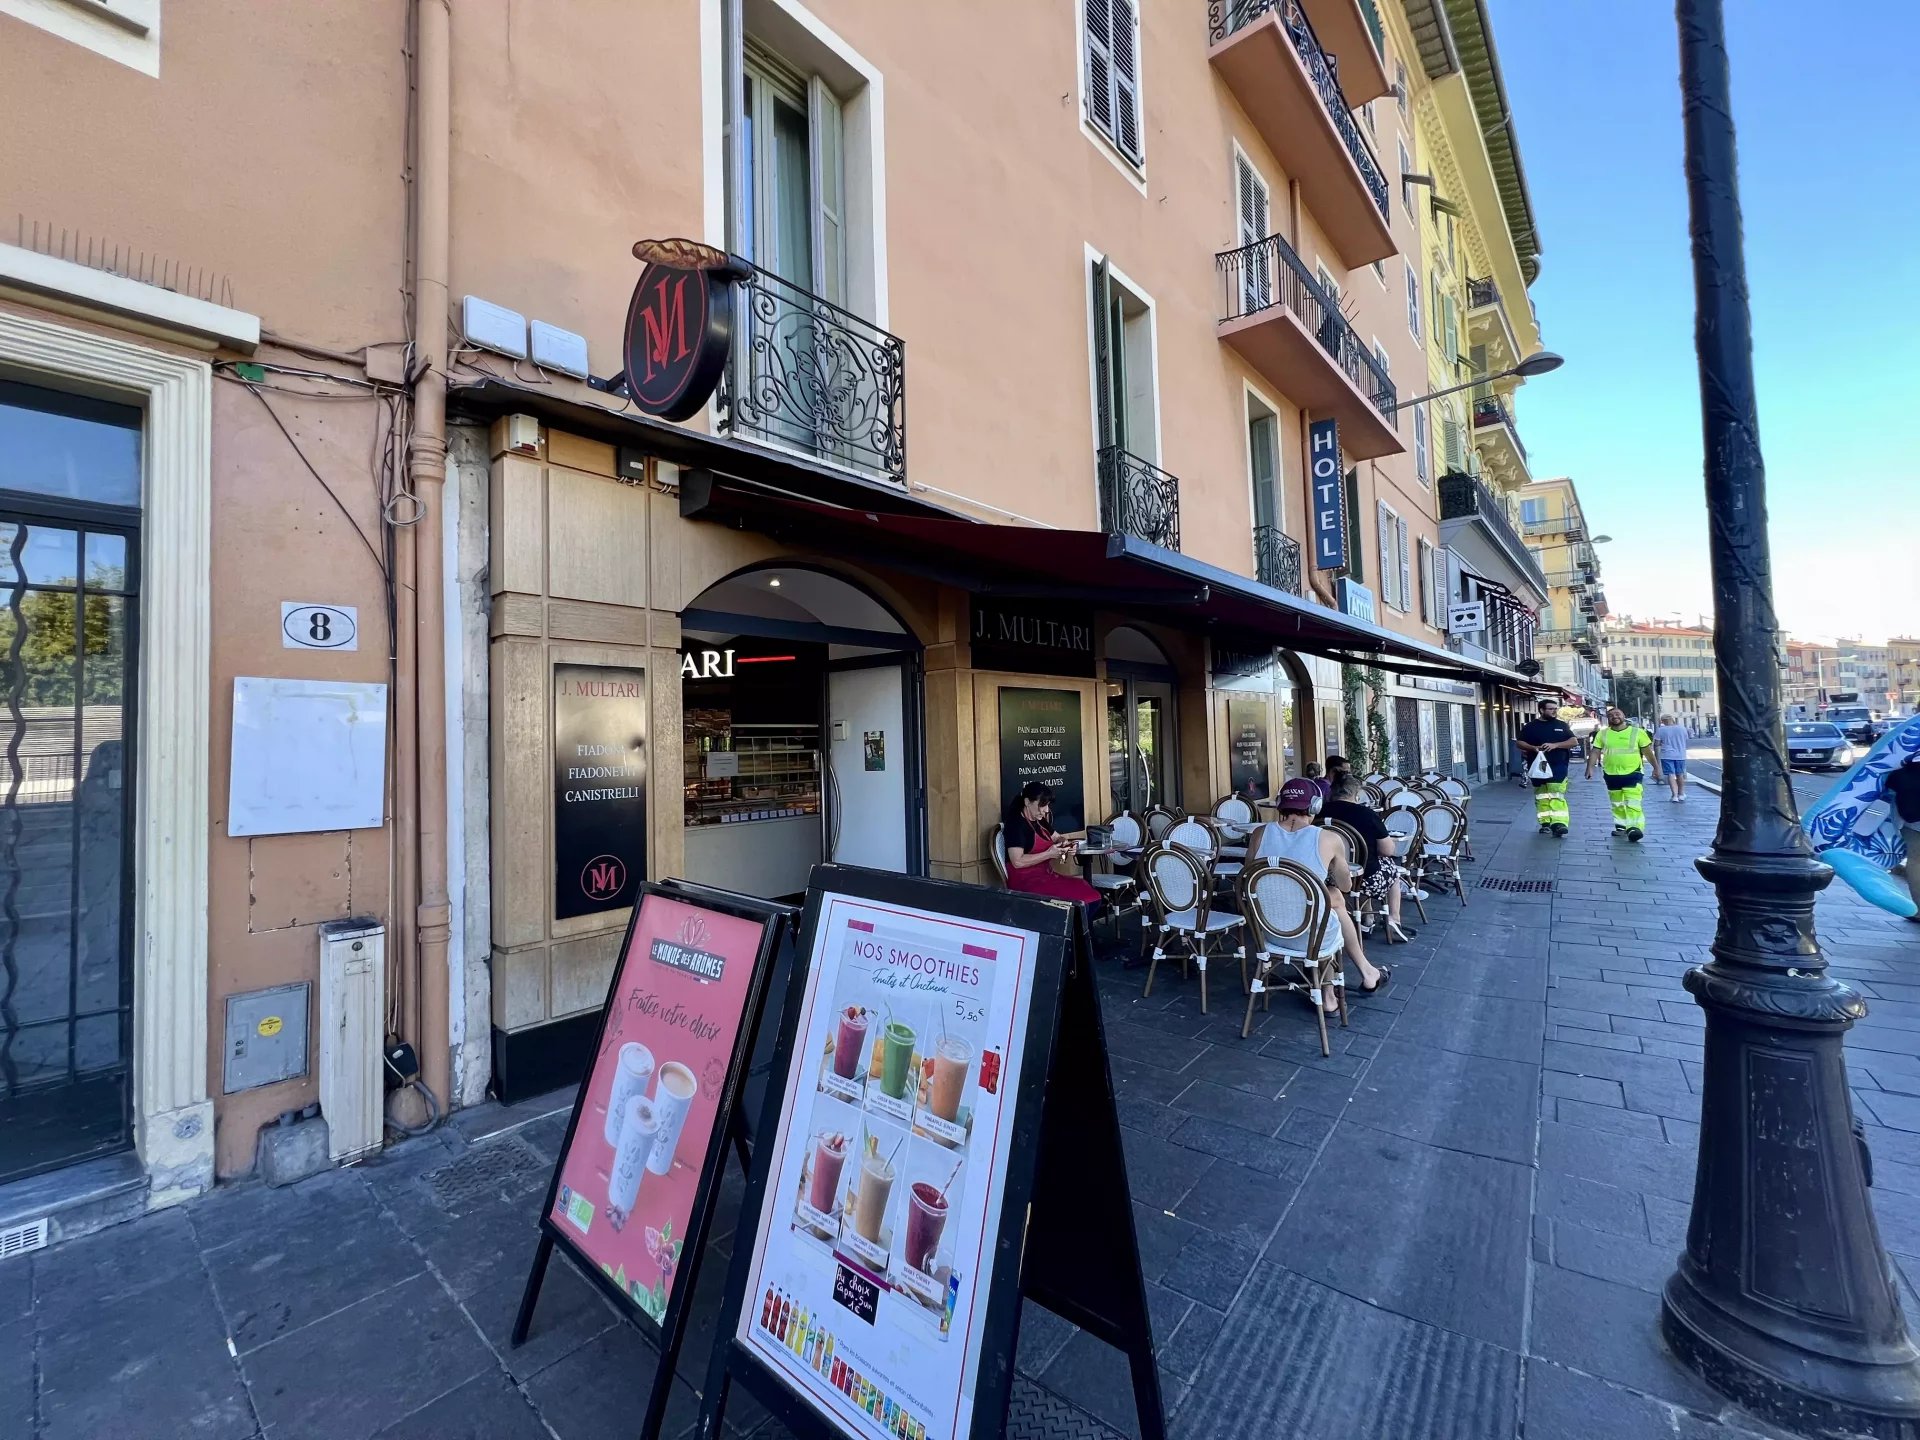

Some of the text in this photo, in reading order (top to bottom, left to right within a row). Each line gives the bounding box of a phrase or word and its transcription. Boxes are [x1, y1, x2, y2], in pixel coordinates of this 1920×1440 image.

[1313, 430, 1337, 557] HOTEL
[309, 612, 331, 641] 8
[976, 609, 1090, 651] J. MULTARI
[562, 680, 640, 698] J. MULTARI
[1017, 726, 1030, 734] PAIN
[1036, 739, 1042, 747] de
[1023, 752, 1061, 761] PAIN COMPLET
[1018, 764, 1067, 775] PAIN de CAMPAGNE
[1044, 778, 1064, 787] OLIVES
[565, 786, 640, 803] CANISTRELLI
[651, 944, 658, 956] LE
[656, 943, 682, 966] MONDE
[680, 953, 692, 966] DES
[689, 953, 724, 979] ARÔMES
[853, 940, 979, 986] NOS SMOOTHIES
[898, 974, 911, 988] et
[909, 972, 949, 994] Onctueux
[628, 988, 721, 1042] Faites votre choix
[848, 1275, 871, 1297] choix
